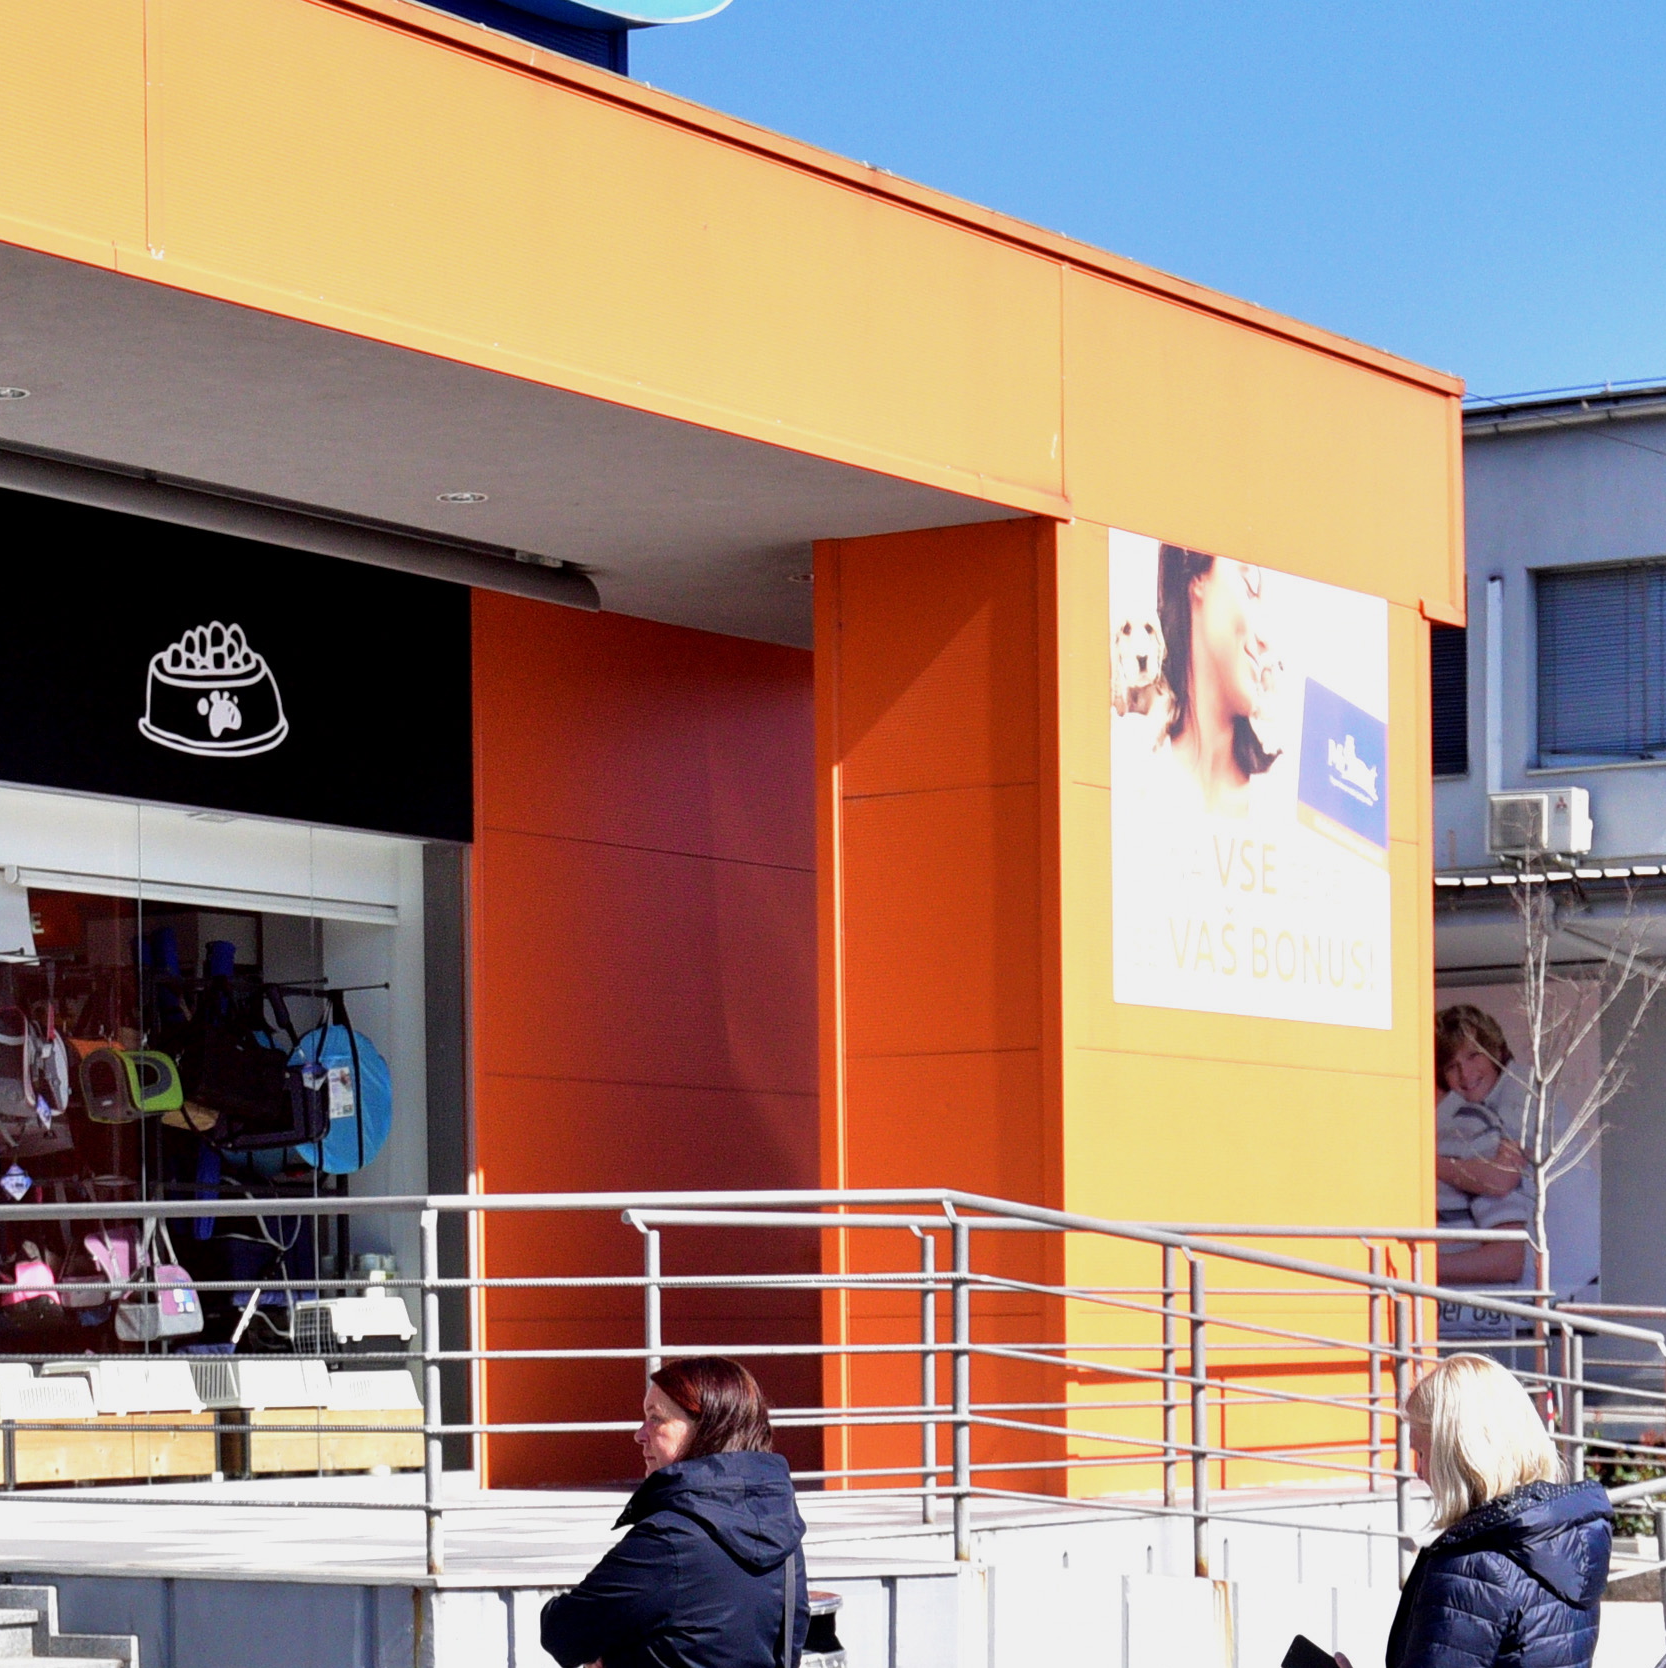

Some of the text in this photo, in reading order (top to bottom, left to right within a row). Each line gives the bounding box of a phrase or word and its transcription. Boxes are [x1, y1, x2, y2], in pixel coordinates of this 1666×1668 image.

[1213, 834, 1277, 895] VSE
[1169, 905, 1237, 976] VAŠ
[1252, 926, 1374, 991] BONUS!
